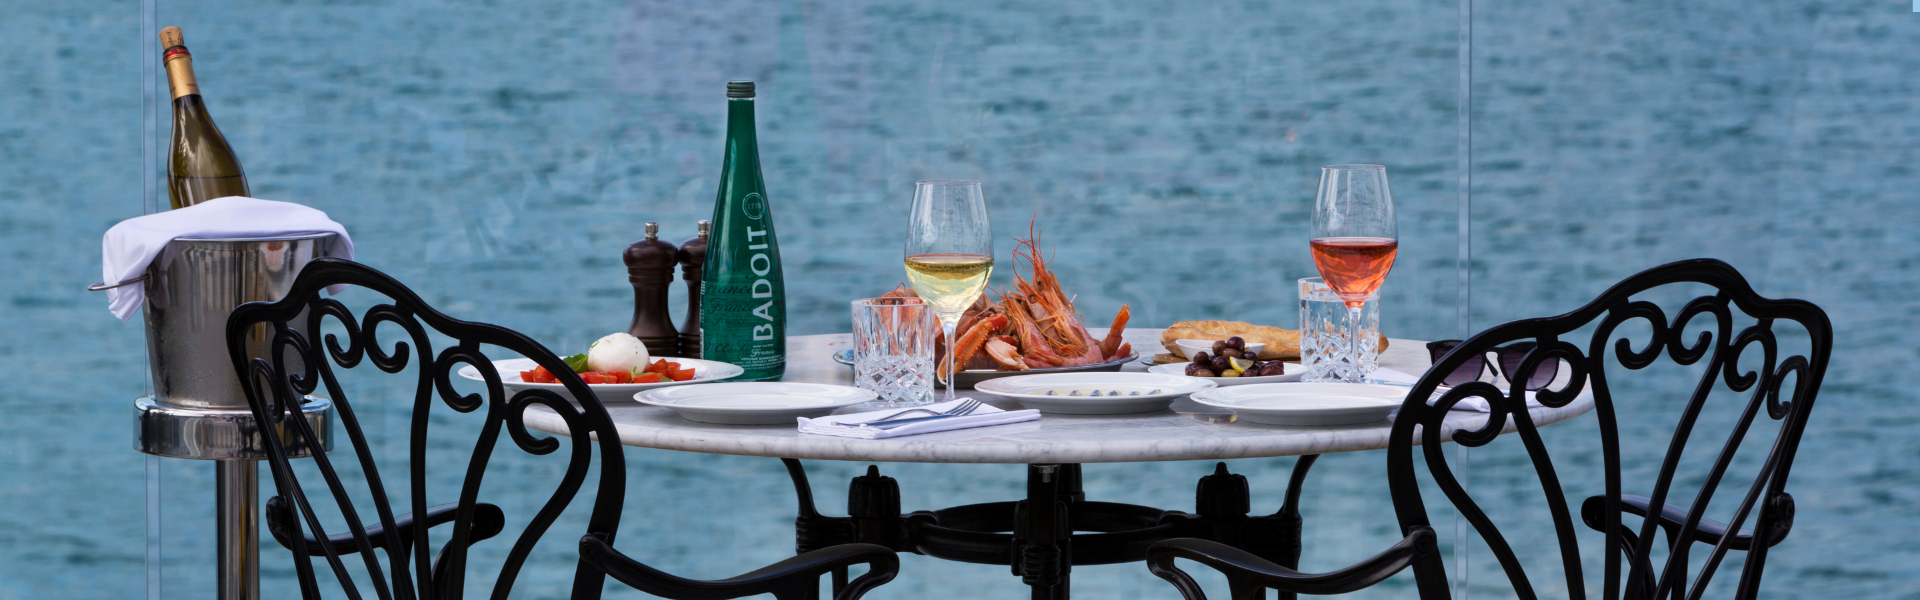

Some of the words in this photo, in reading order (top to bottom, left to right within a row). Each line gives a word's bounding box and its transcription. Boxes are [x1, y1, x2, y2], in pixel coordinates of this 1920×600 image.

[747, 202, 762, 210] 1778
[746, 226, 774, 341] BADOIT
[707, 297, 755, 314] France
[712, 313, 746, 326] France
